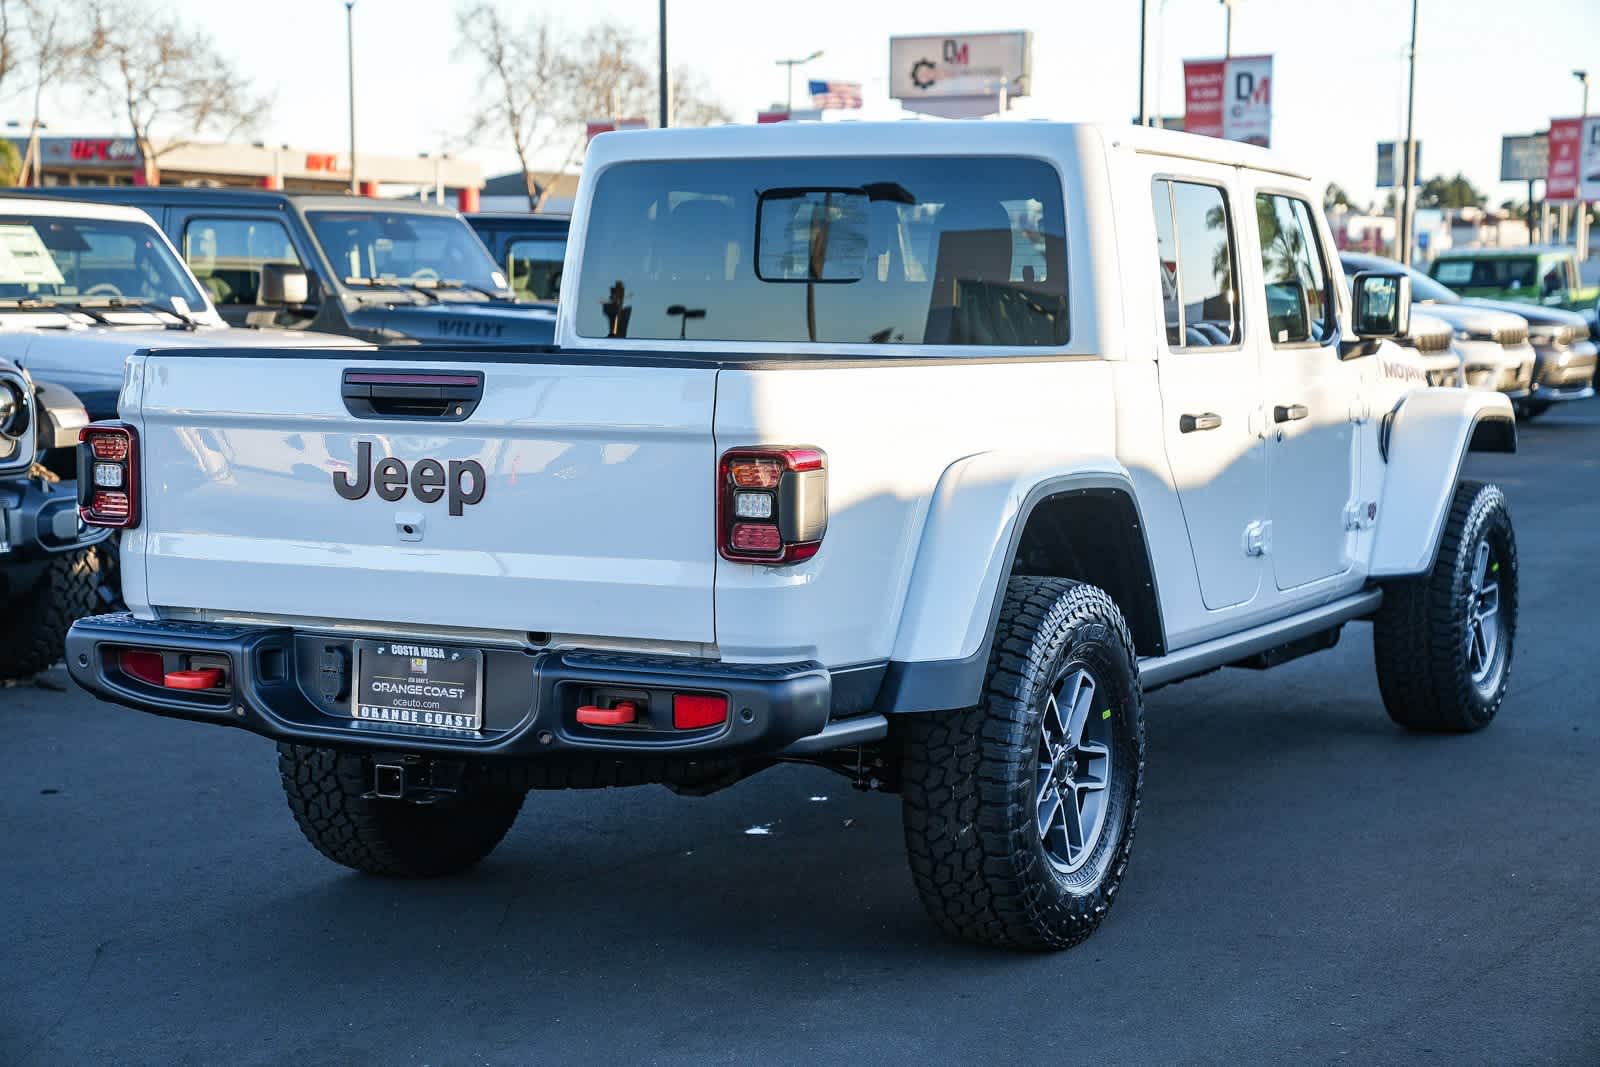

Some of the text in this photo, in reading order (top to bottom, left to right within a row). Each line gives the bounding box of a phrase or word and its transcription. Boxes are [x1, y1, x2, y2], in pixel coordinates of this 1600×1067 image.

[333, 441, 486, 516] Jeep
[391, 644, 445, 659] COSTA MESA
[393, 698, 440, 710] ocauto.com
[361, 706, 473, 728] ORANGE COAST
